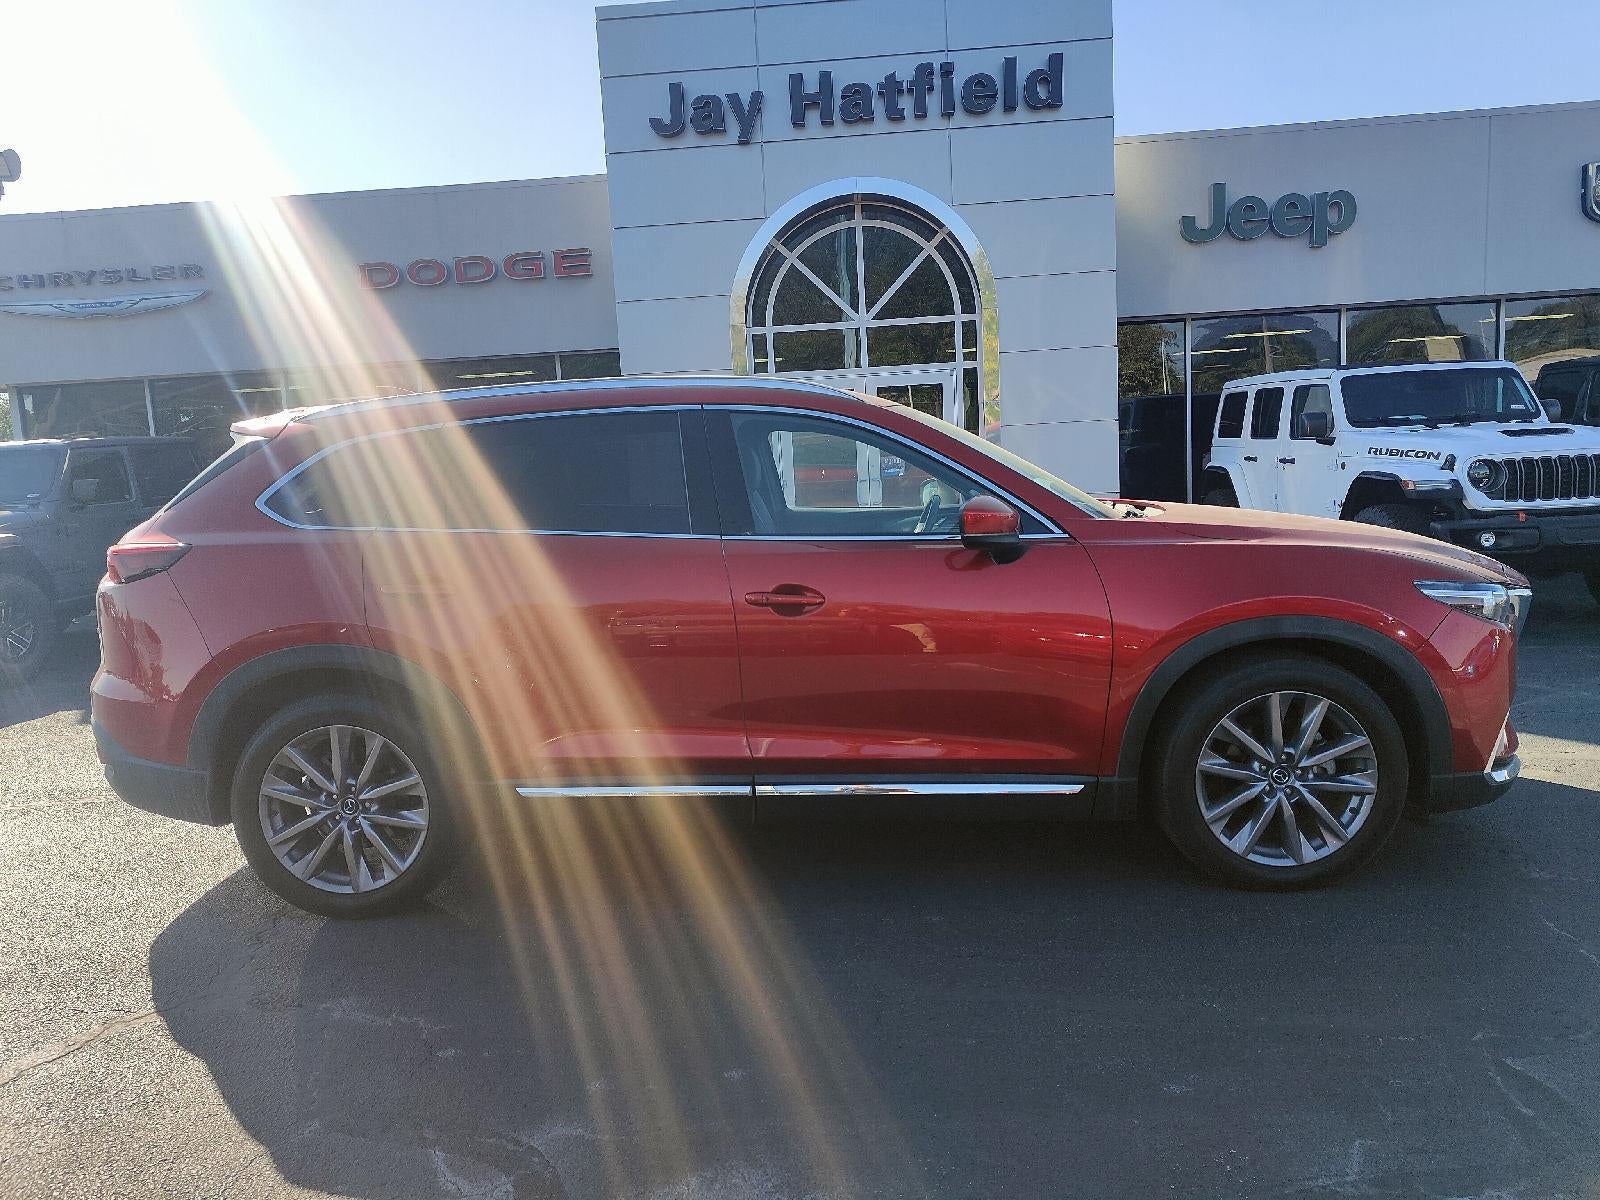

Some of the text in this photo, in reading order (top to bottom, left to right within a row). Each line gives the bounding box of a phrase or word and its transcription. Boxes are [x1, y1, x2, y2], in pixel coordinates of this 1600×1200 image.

[648, 52, 1064, 144] Jay Hatfield
[1180, 182, 1357, 248] Jeep
[359, 247, 592, 289] DODGE
[1367, 446, 1441, 461] RUBICON
